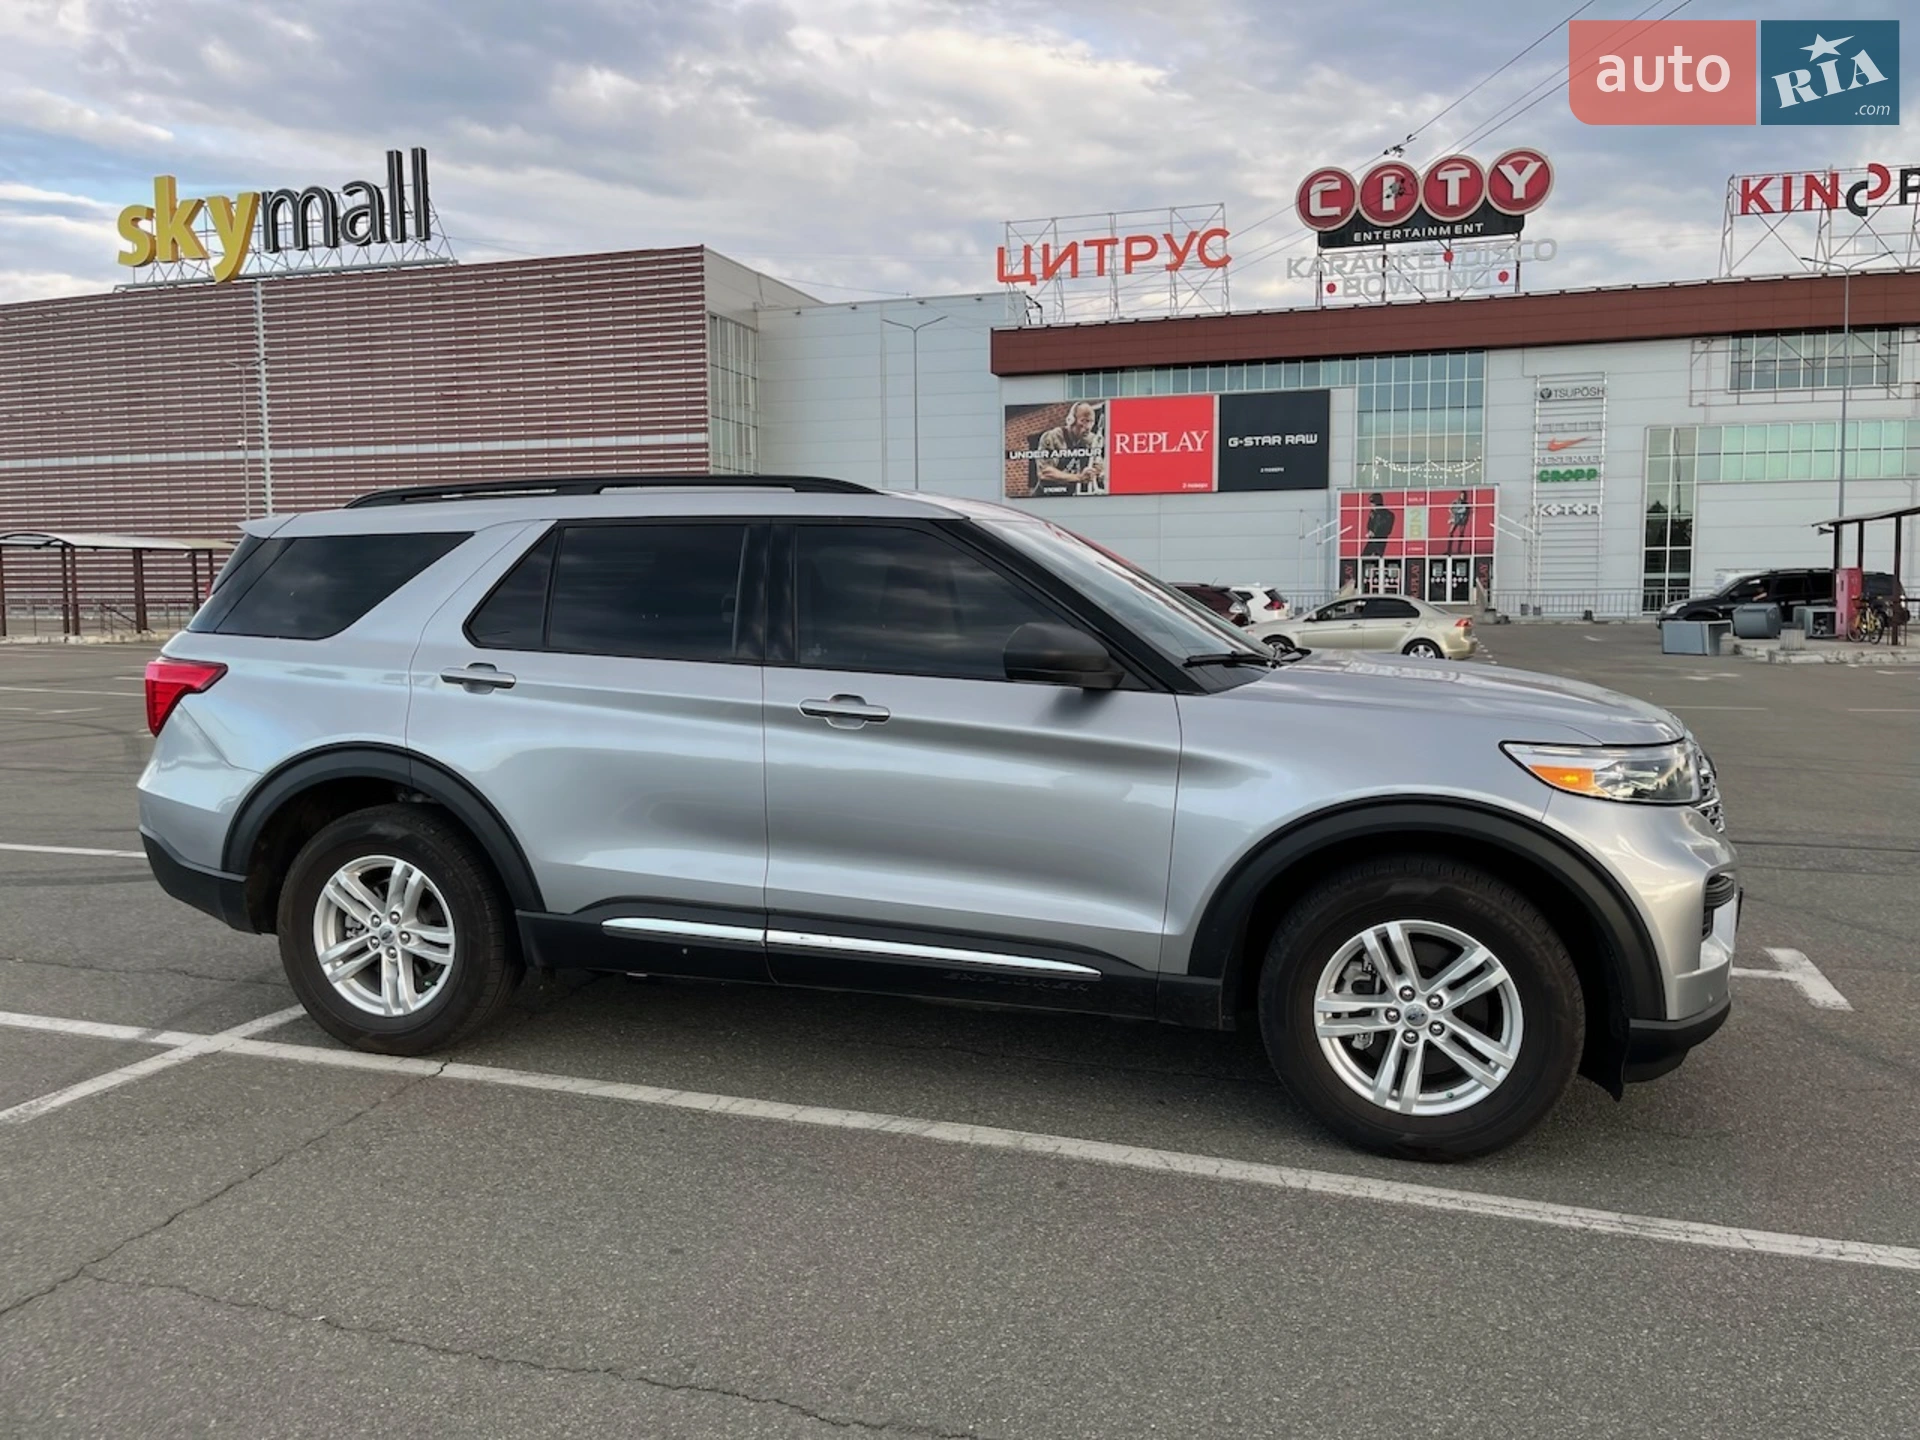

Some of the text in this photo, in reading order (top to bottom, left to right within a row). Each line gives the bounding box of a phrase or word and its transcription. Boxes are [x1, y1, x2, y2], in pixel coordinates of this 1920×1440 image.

[1308, 161, 1543, 217] CITY
[1353, 222, 1484, 242] ENTERTAINMENT
[997, 228, 1233, 286] ЦИТРУС
[1286, 238, 1558, 280] KARAOKE DISCO
[1343, 268, 1490, 298] BOWLING
[1114, 430, 1209, 454] REPLAY
[1228, 433, 1318, 448] G-STAR RAW
[1009, 448, 1102, 460] UNDER ARMOUR
[1539, 468, 1598, 482] CROPP
